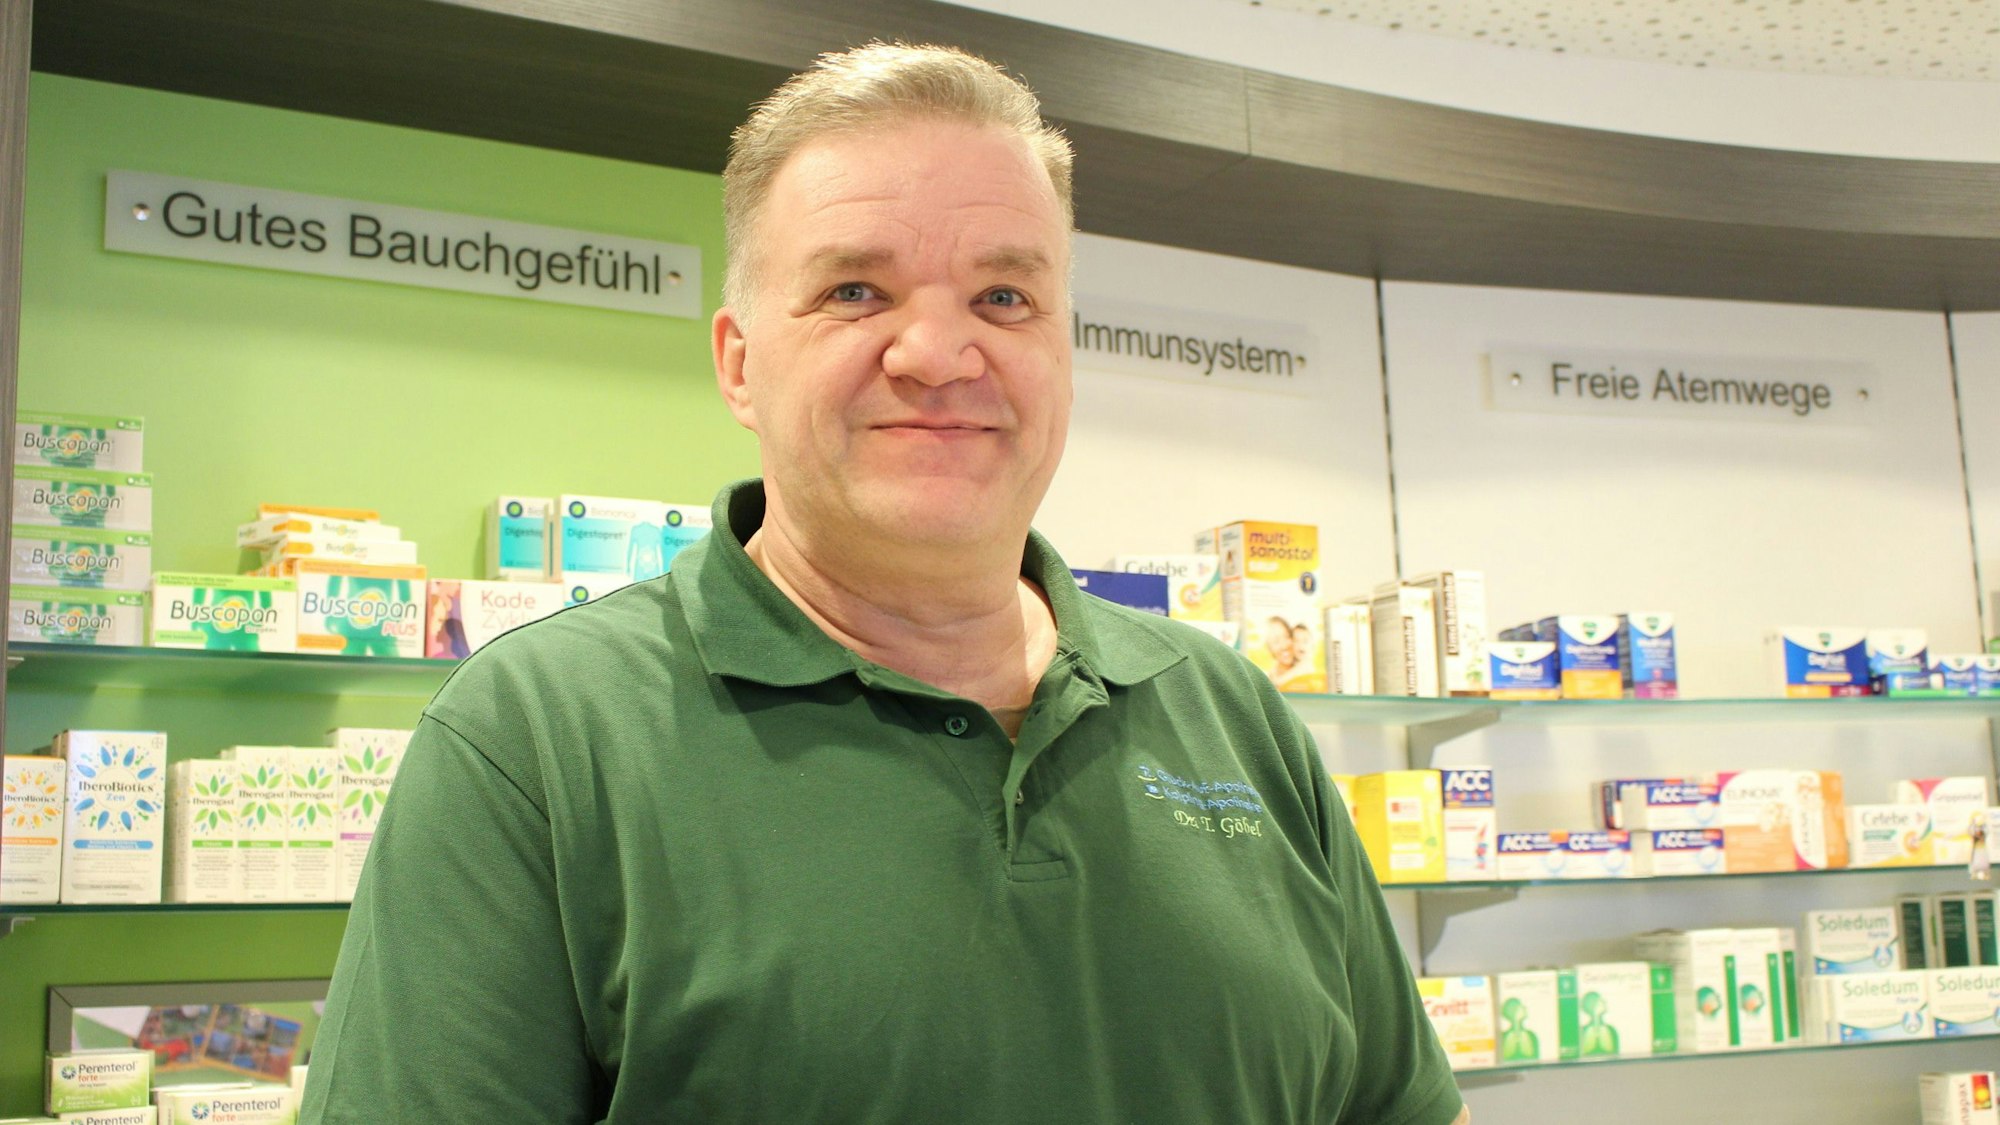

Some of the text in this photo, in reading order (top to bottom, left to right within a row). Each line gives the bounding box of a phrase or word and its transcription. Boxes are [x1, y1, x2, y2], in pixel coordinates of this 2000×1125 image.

[161, 191, 661, 296] Gutes Bauchgefühl
[1073, 311, 1294, 377] Immunsystem
[1551, 362, 1832, 417] Freie Atemwege
[23, 431, 113, 455] Buscopan
[32, 487, 122, 511] Buscopan
[31, 548, 121, 571] Buscopan
[1123, 559, 1189, 579] Cetebe
[303, 591, 418, 623] Buscopan
[481, 589, 537, 610] Kade
[23, 608, 113, 631] Buscopan
[170, 599, 279, 629] Buscopan
[382, 620, 418, 637] PLUS
[78, 780, 154, 794] IberoBiotics
[1445, 771, 1490, 792] ACC
[106, 793, 126, 802] Zen
[1650, 785, 1681, 804] ACC
[1220, 816, 1262, 838] Göbel
[1502, 834, 1533, 851] ACC
[1656, 830, 1687, 849] ACC
[1817, 914, 1890, 933] Soledum
[1842, 979, 1920, 998] Soledum
[78, 1061, 136, 1074] Perenterol
[78, 1074, 98, 1082] forte
[213, 1097, 281, 1112] Perenterol
[86, 1115, 143, 1125] Perenterol
